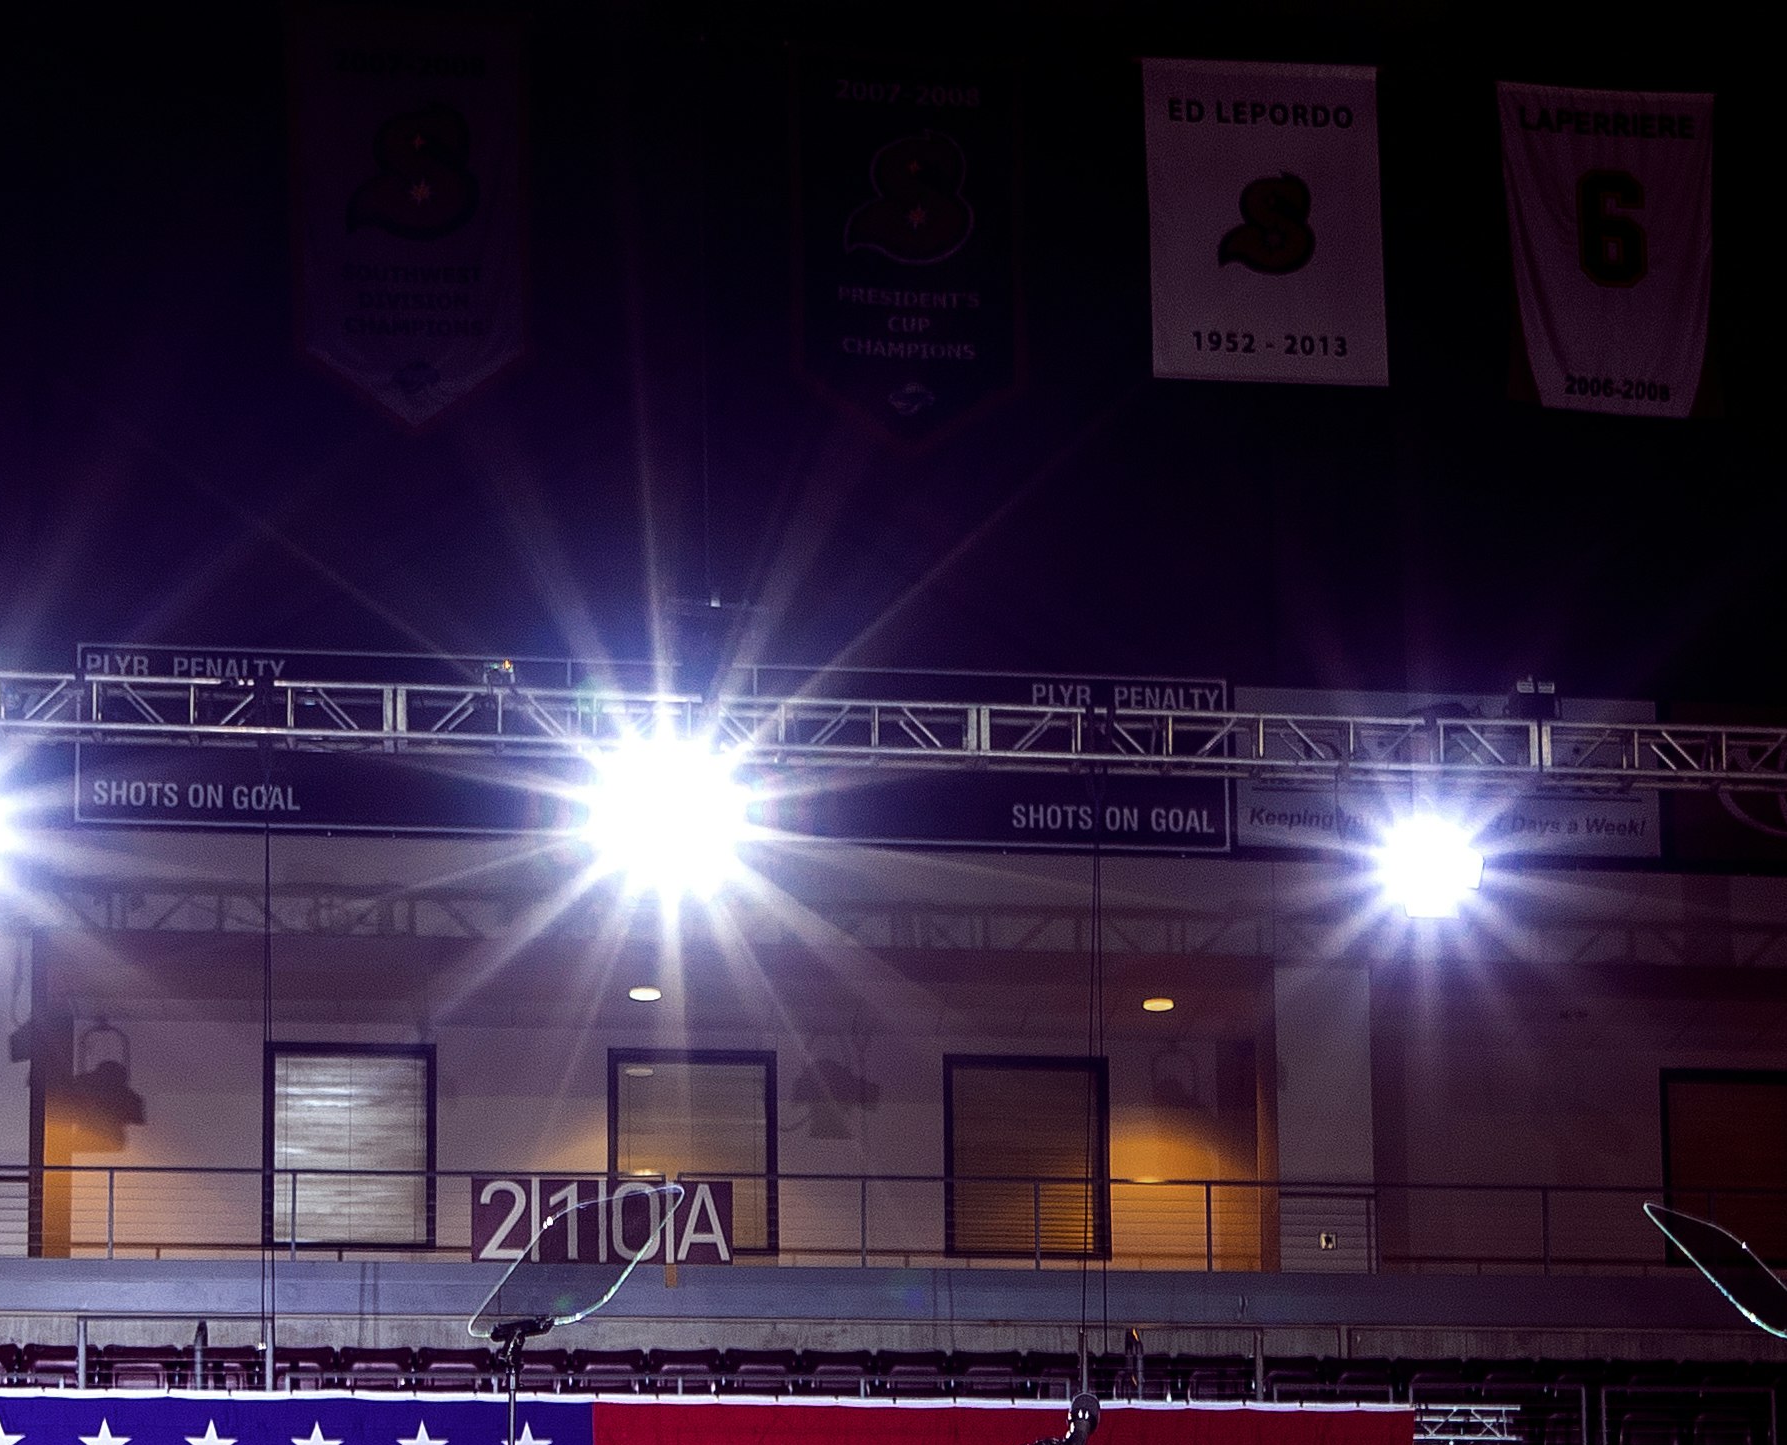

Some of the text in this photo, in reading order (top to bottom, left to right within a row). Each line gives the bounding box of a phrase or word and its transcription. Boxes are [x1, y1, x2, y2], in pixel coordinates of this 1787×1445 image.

[835, 78, 981, 108] 2007-2008
[1168, 98, 1353, 128] ED LEPORDO
[1520, 105, 1695, 138] LAPERRIERE
[1576, 169, 1648, 288] 6
[341, 264, 481, 283] SOUTHWEST
[358, 291, 469, 310] DIVISION
[837, 285, 980, 309] PRESIDENT'S
[344, 317, 485, 336] CHAMPIONS
[887, 315, 931, 333] CUP
[842, 336, 976, 360] CHAMPIONS
[1193, 331, 1256, 354] 1952
[1284, 335, 1348, 357] 2013
[1565, 373, 1670, 402] 2006-2008
[1031, 683, 1220, 710] PLYR PENALTY
[93, 779, 301, 811] SHOTS ON GOAL
[1012, 803, 1215, 834] SHOTS ON GOAL
[1249, 807, 1334, 831] Keeping
[1586, 817, 1647, 837] Week!
